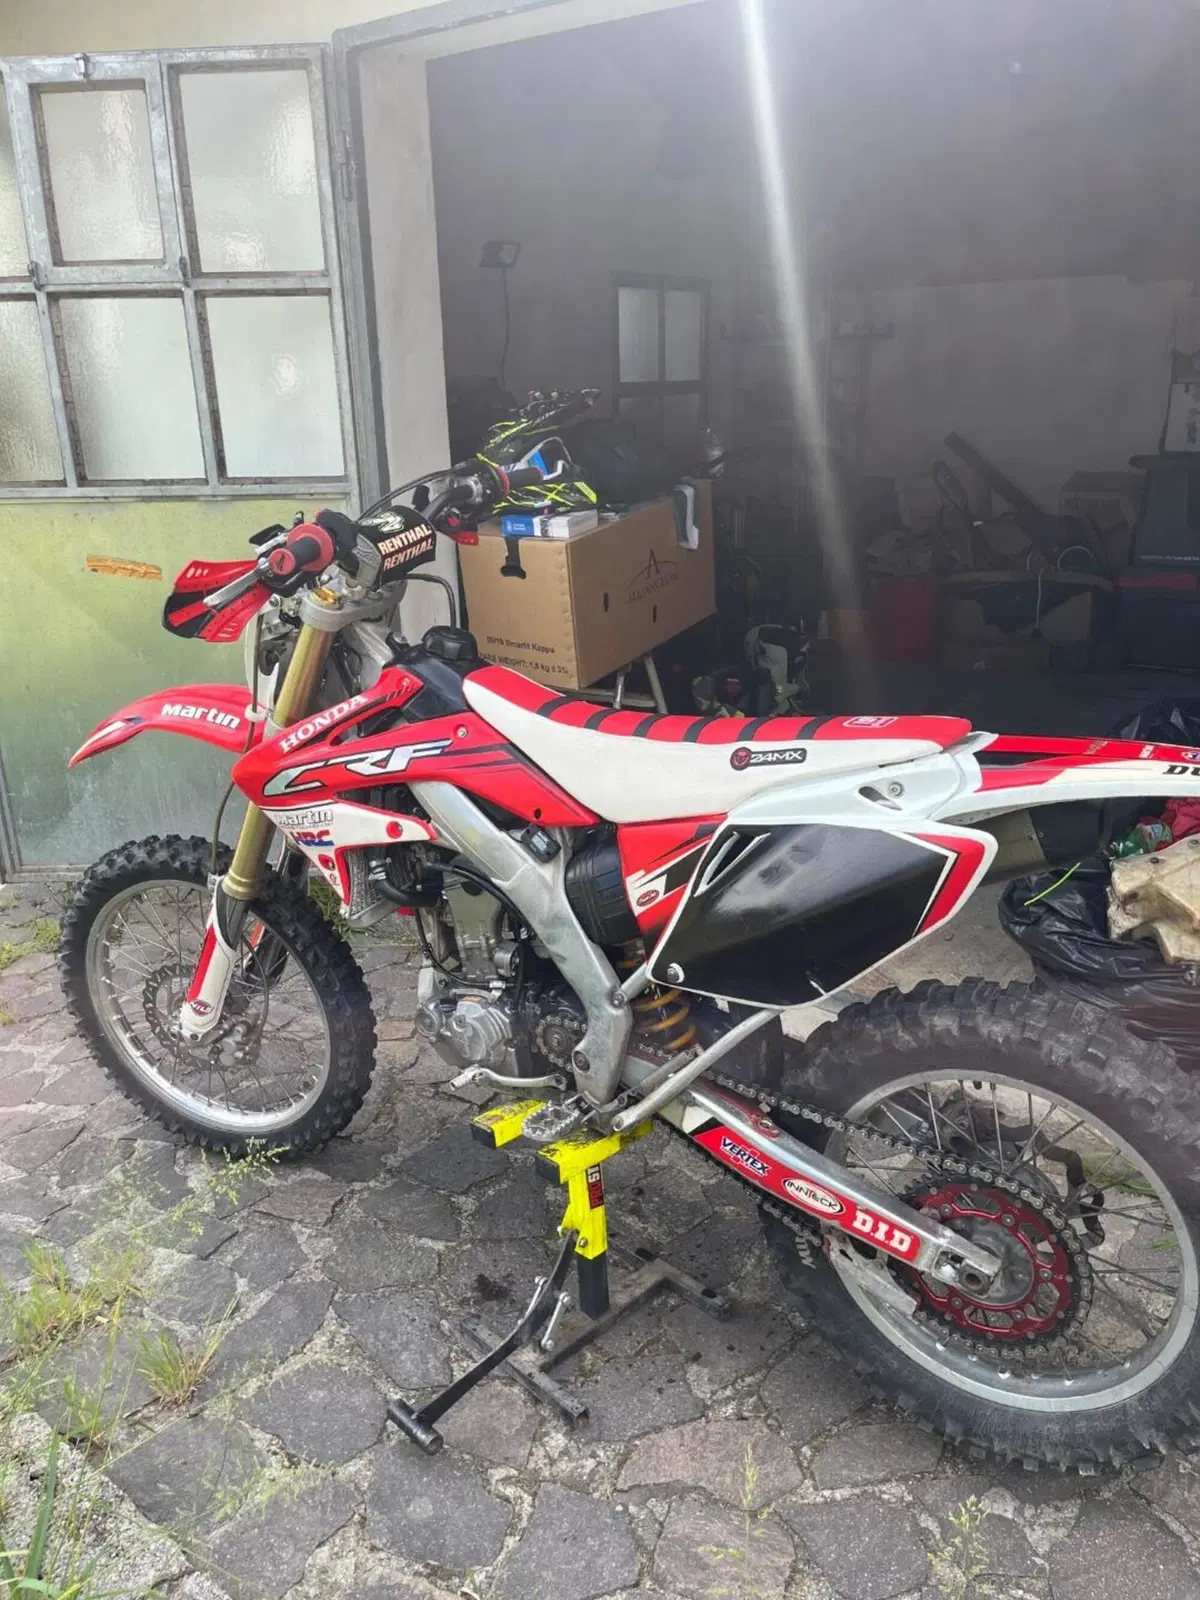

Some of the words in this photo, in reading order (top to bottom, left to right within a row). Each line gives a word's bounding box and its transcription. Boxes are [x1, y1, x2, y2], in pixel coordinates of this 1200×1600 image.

[377, 524, 432, 555] RENTHAL
[383, 538, 433, 571] RENTHAL
[531, 643, 555, 654] Kappa
[541, 663, 550, 673] kg
[161, 703, 241, 729] Martin
[279, 694, 369, 753] HONDA
[262, 738, 453, 796] CRF
[751, 750, 803, 763] 24MX
[276, 809, 334, 826] Martin
[722, 1136, 770, 1174] VERTEX
[852, 1208, 912, 1253] D.I.D
